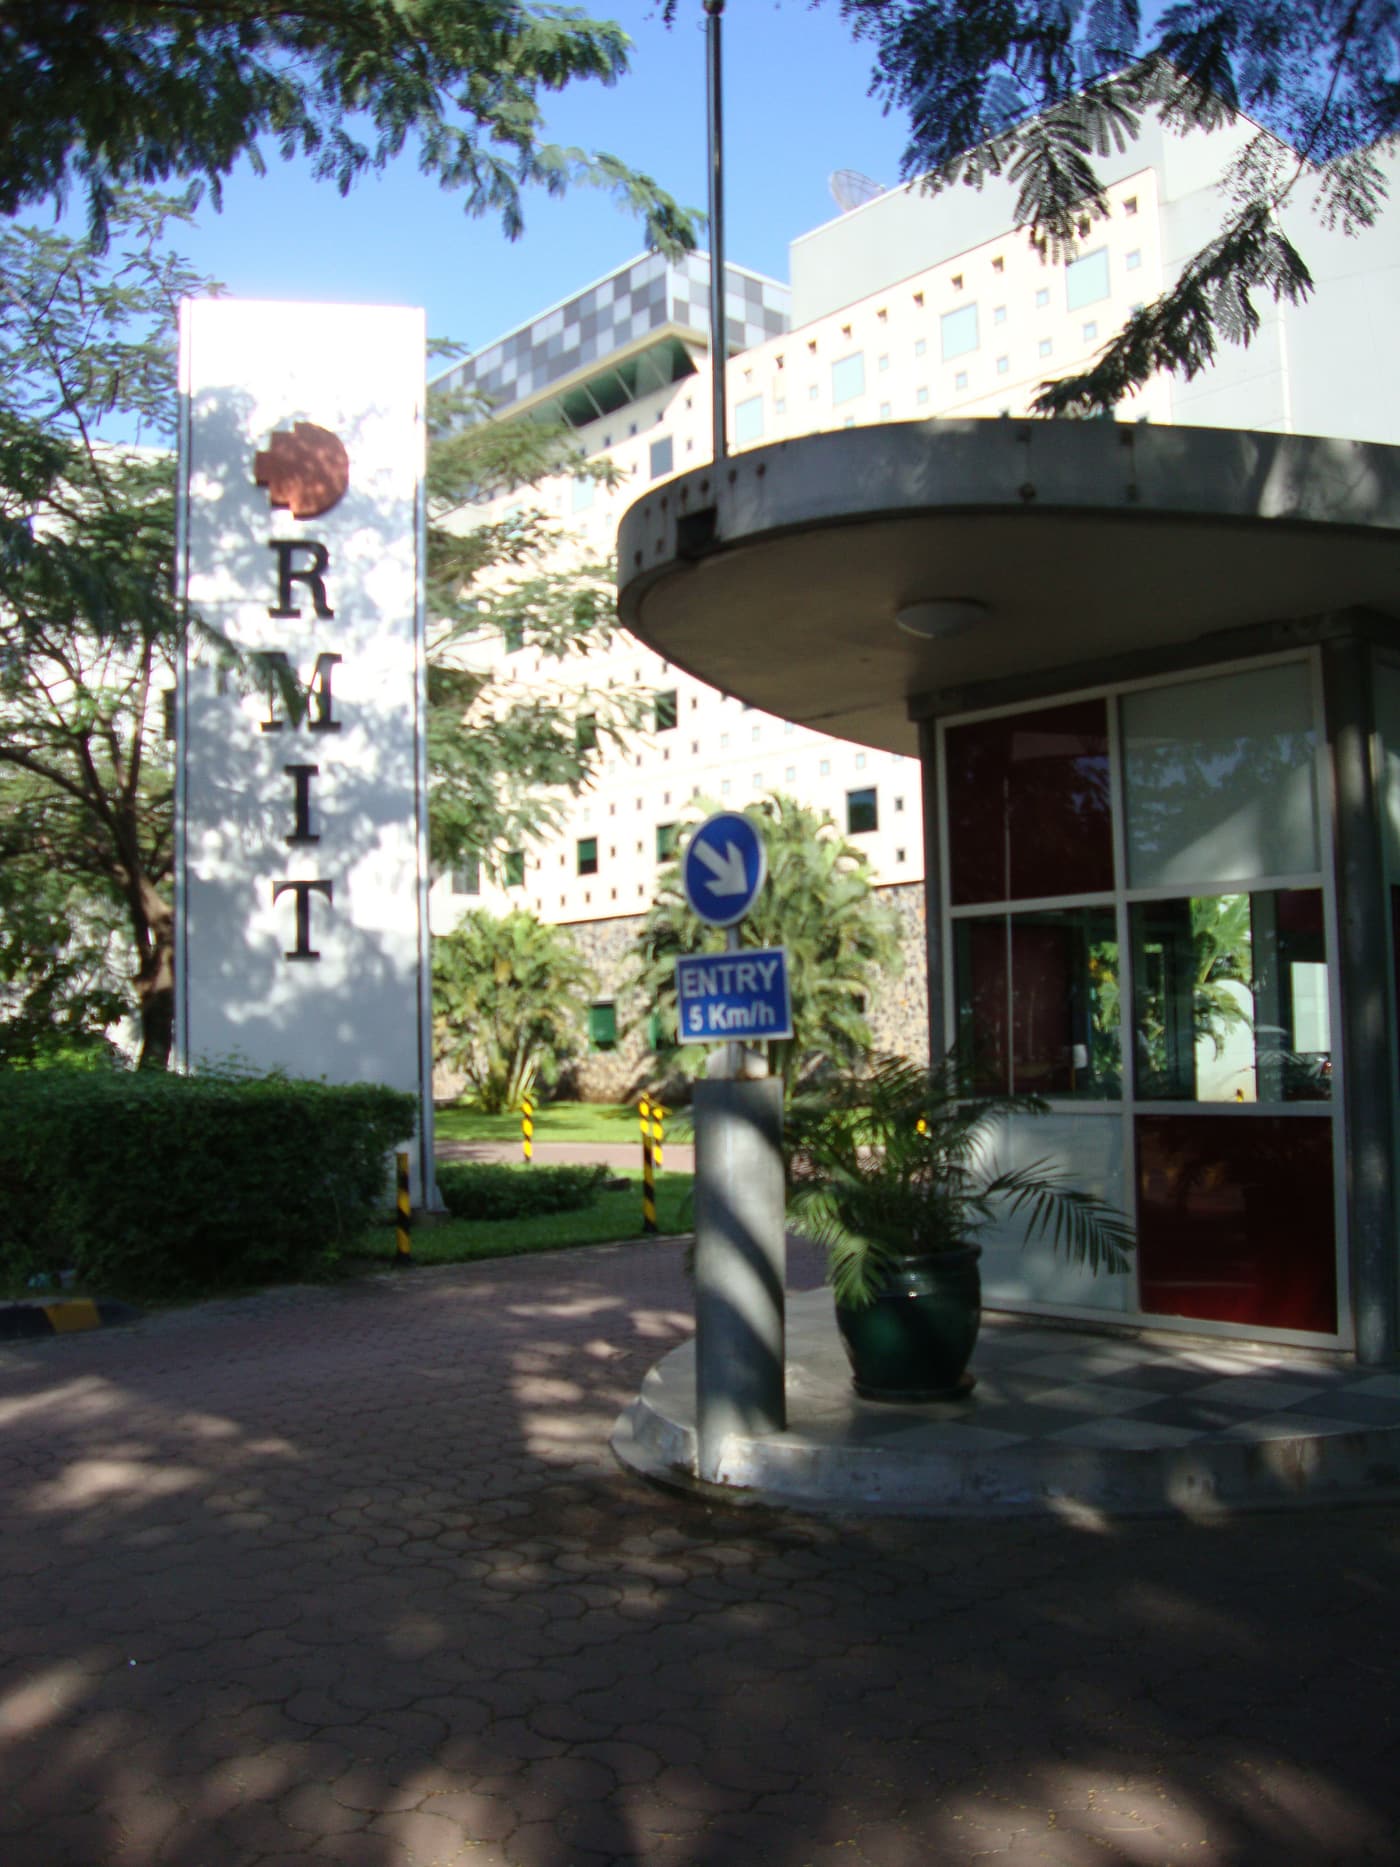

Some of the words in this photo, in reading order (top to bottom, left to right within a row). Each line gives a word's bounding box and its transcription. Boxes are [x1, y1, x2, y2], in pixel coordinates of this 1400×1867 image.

[260, 539, 343, 962] RMIT
[682, 959, 778, 998] ENTRY
[689, 1005, 703, 1032] 5
[708, 1000, 775, 1031] Km/h
